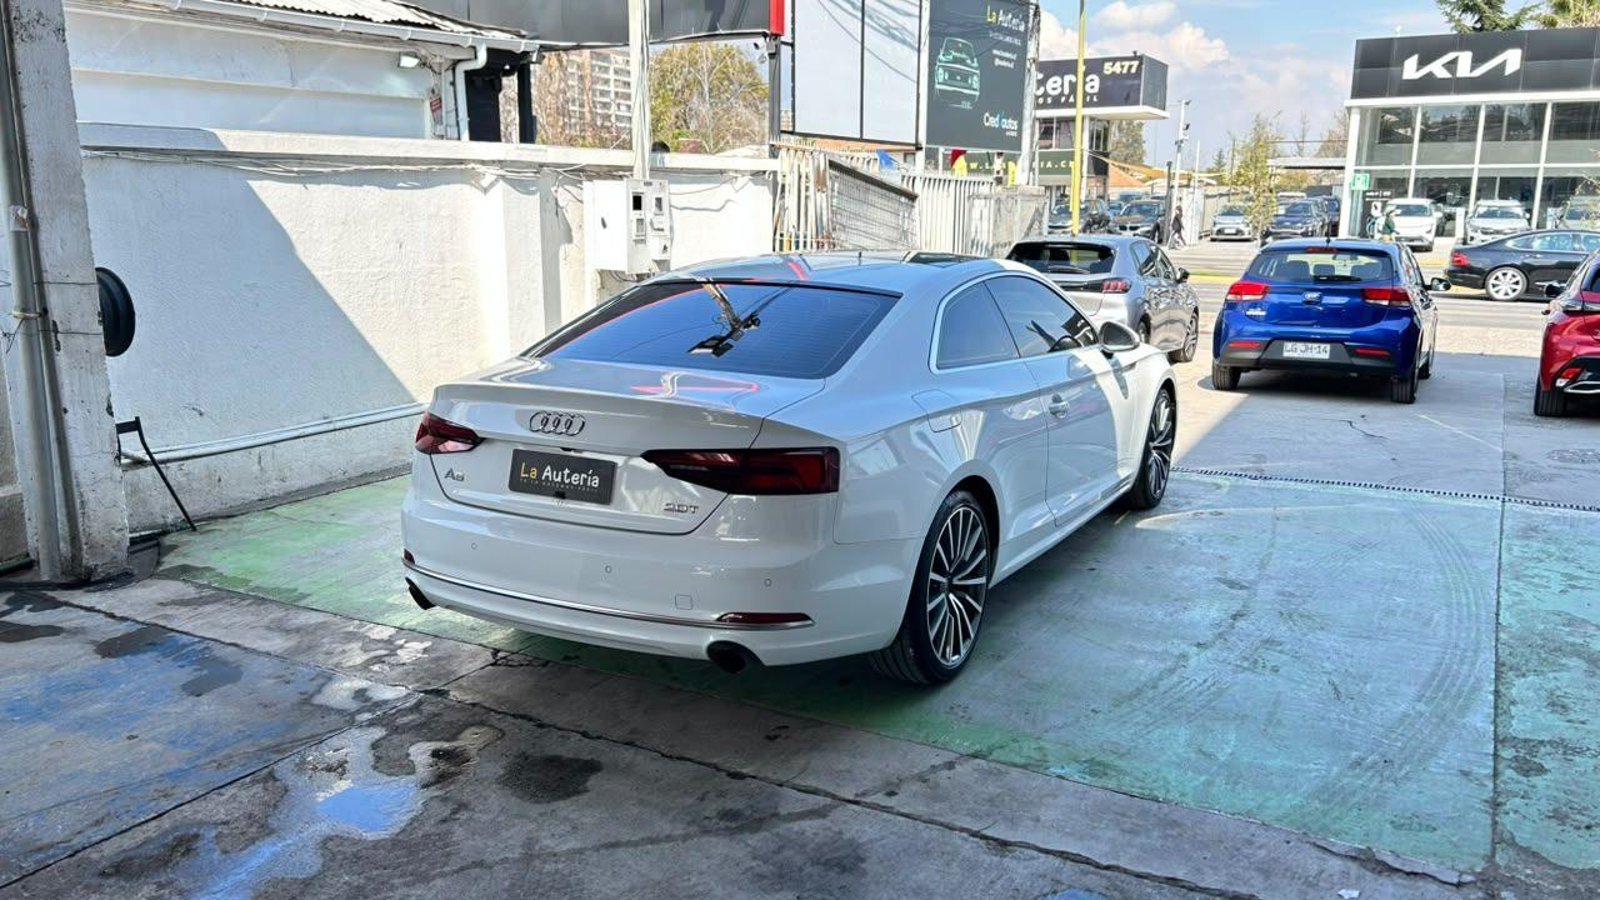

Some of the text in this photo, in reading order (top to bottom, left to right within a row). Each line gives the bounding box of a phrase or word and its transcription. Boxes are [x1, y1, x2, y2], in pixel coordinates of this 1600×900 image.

[1103, 61, 1139, 75] 5477
[1402, 48, 1522, 80] KIA
[1035, 65, 1100, 96] tera
[520, 462, 538, 480] La
[541, 465, 600, 488] Autería
